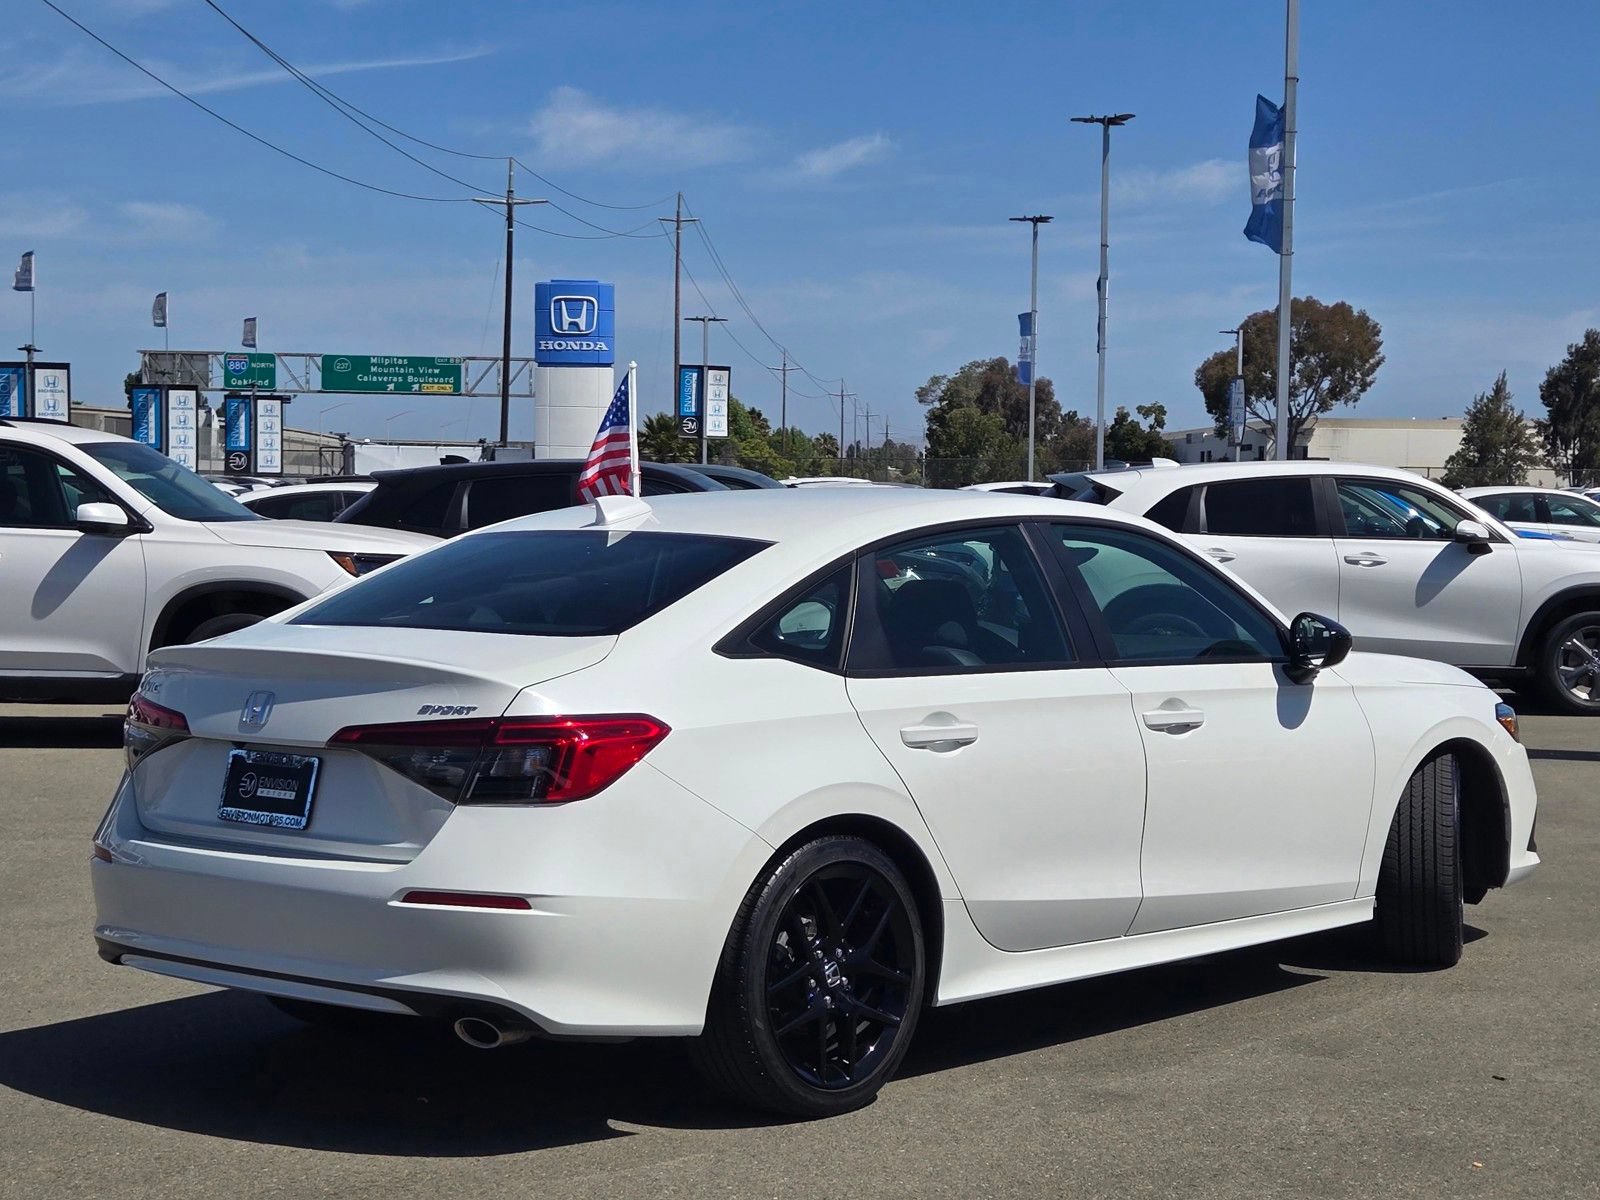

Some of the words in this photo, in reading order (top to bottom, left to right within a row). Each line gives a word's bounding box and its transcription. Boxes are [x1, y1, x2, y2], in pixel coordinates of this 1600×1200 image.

[539, 341, 609, 350] HONDA
[229, 361, 246, 370] 880
[370, 357, 408, 365] Milpitas
[418, 366, 440, 374] View
[357, 374, 403, 382] Calaveras
[407, 375, 454, 383] Boulevard
[0, 374, 10, 417] VISION
[684, 372, 693, 412] ENVISION
[258, 776, 299, 791] ENVISION
[221, 809, 303, 827] ENVISIONMOTORS.COM
